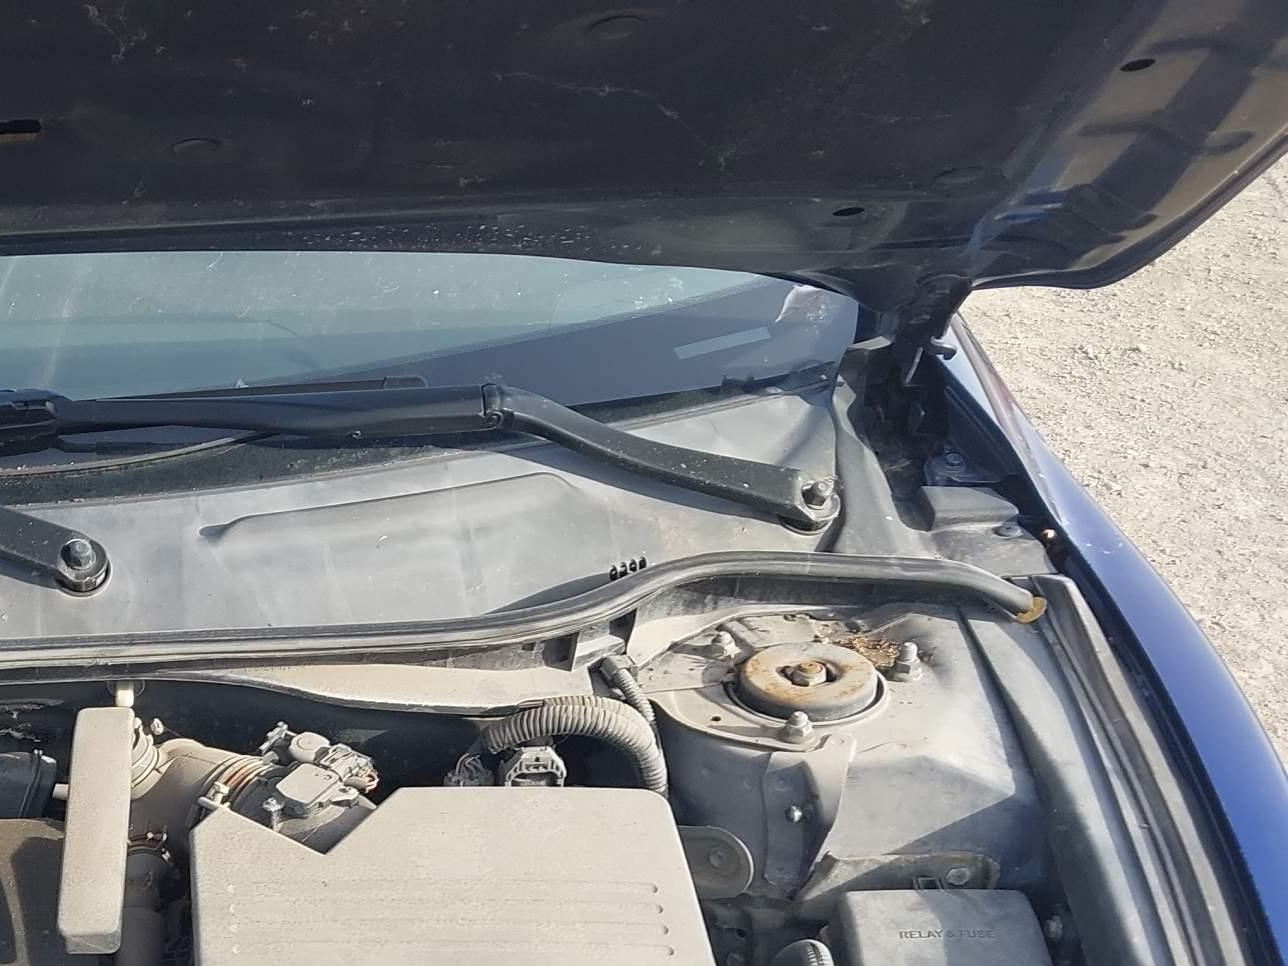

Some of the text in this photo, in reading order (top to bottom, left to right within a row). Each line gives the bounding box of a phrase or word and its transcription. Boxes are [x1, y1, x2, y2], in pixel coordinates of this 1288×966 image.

[899, 929, 996, 939] RELAY & FUSE
